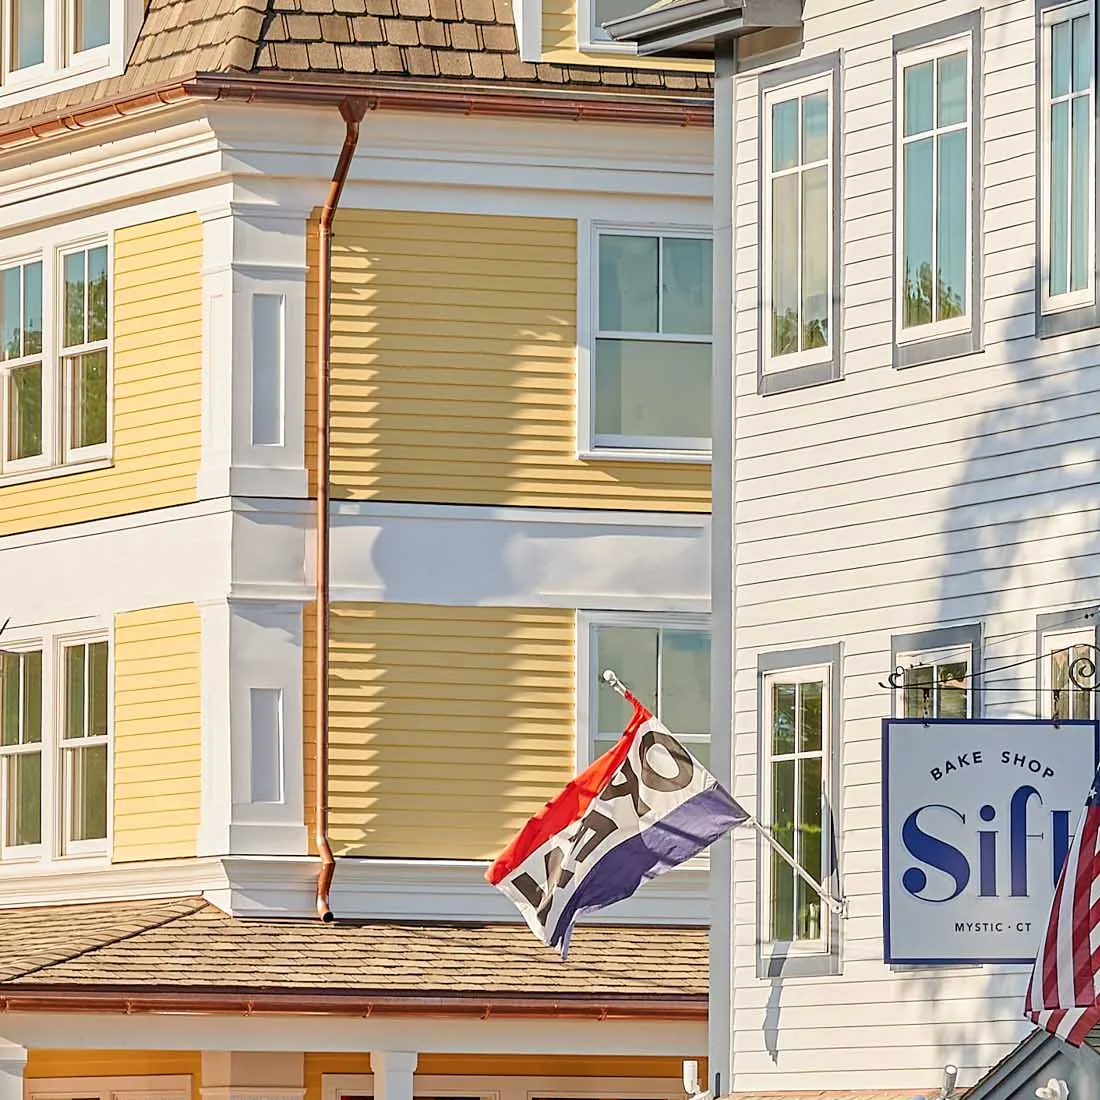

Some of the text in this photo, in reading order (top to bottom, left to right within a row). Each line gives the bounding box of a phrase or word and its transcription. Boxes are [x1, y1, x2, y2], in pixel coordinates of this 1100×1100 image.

[930, 751, 1055, 781] BAKE SHOP
[954, 923, 1031, 932] MYSTIC CT
